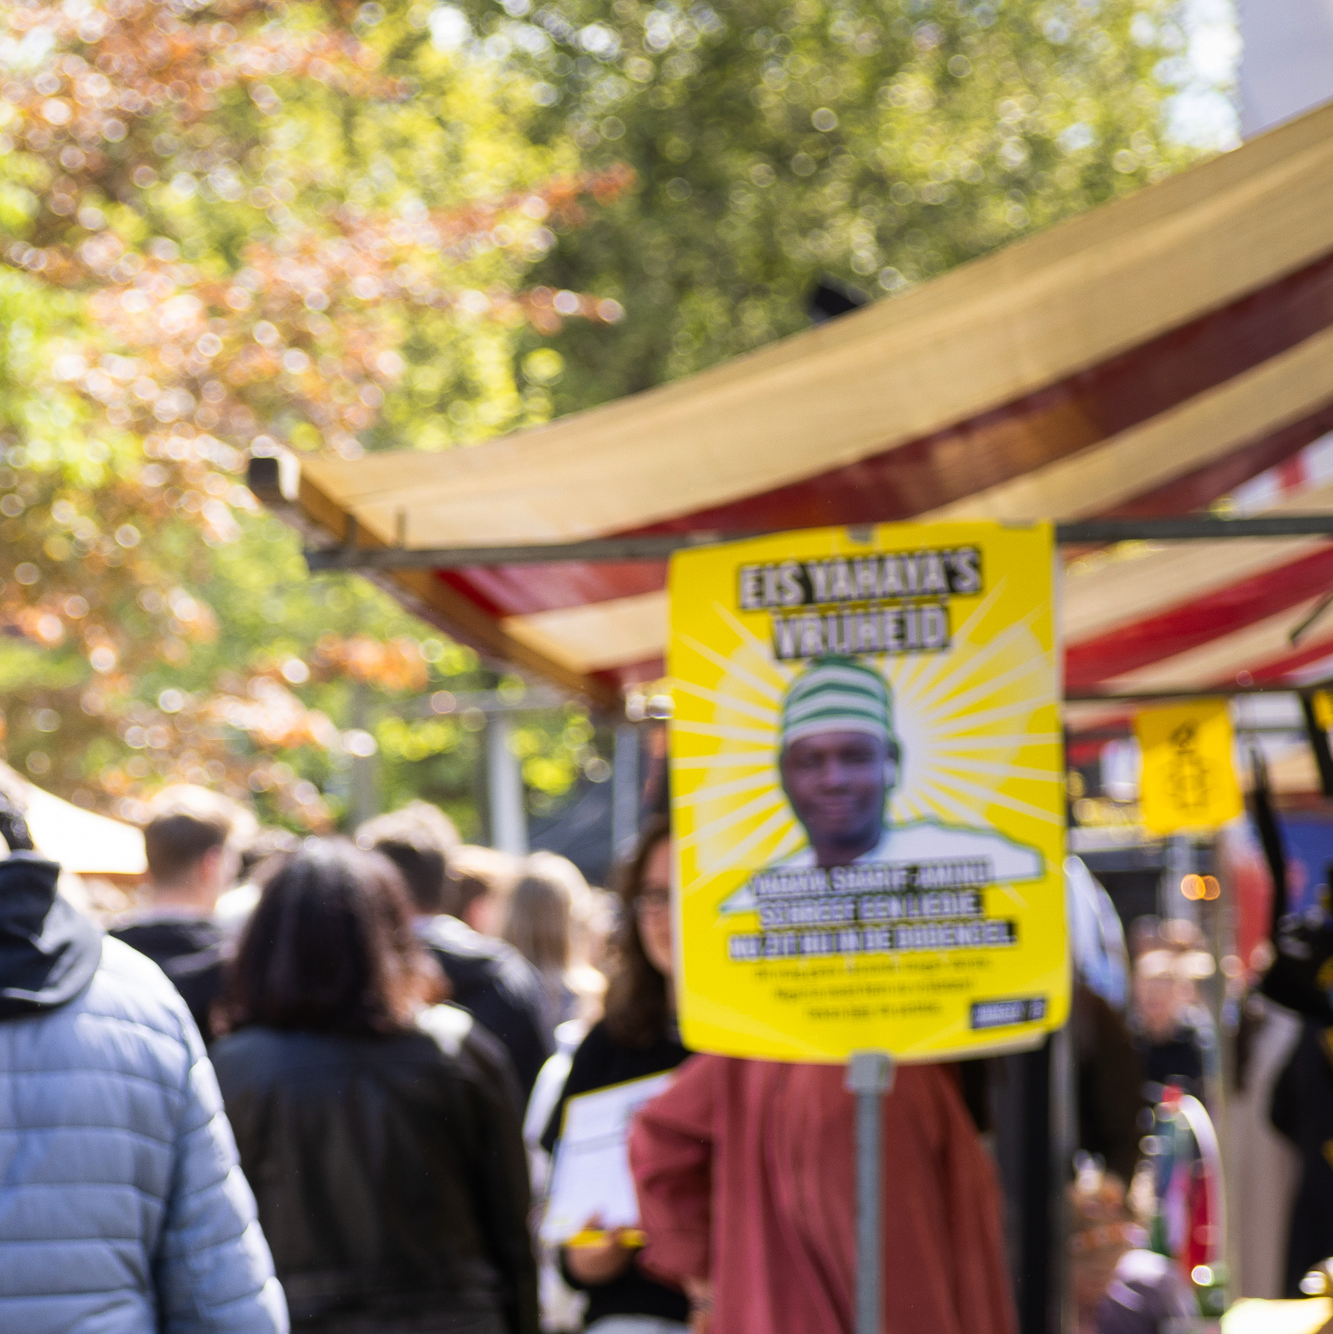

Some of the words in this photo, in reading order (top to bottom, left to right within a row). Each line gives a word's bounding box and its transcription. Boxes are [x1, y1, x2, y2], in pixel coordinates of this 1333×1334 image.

[741, 564, 804, 609] EIS
[807, 547, 981, 600] YAHAYA'S
[775, 604, 947, 658] VRIJHEID
